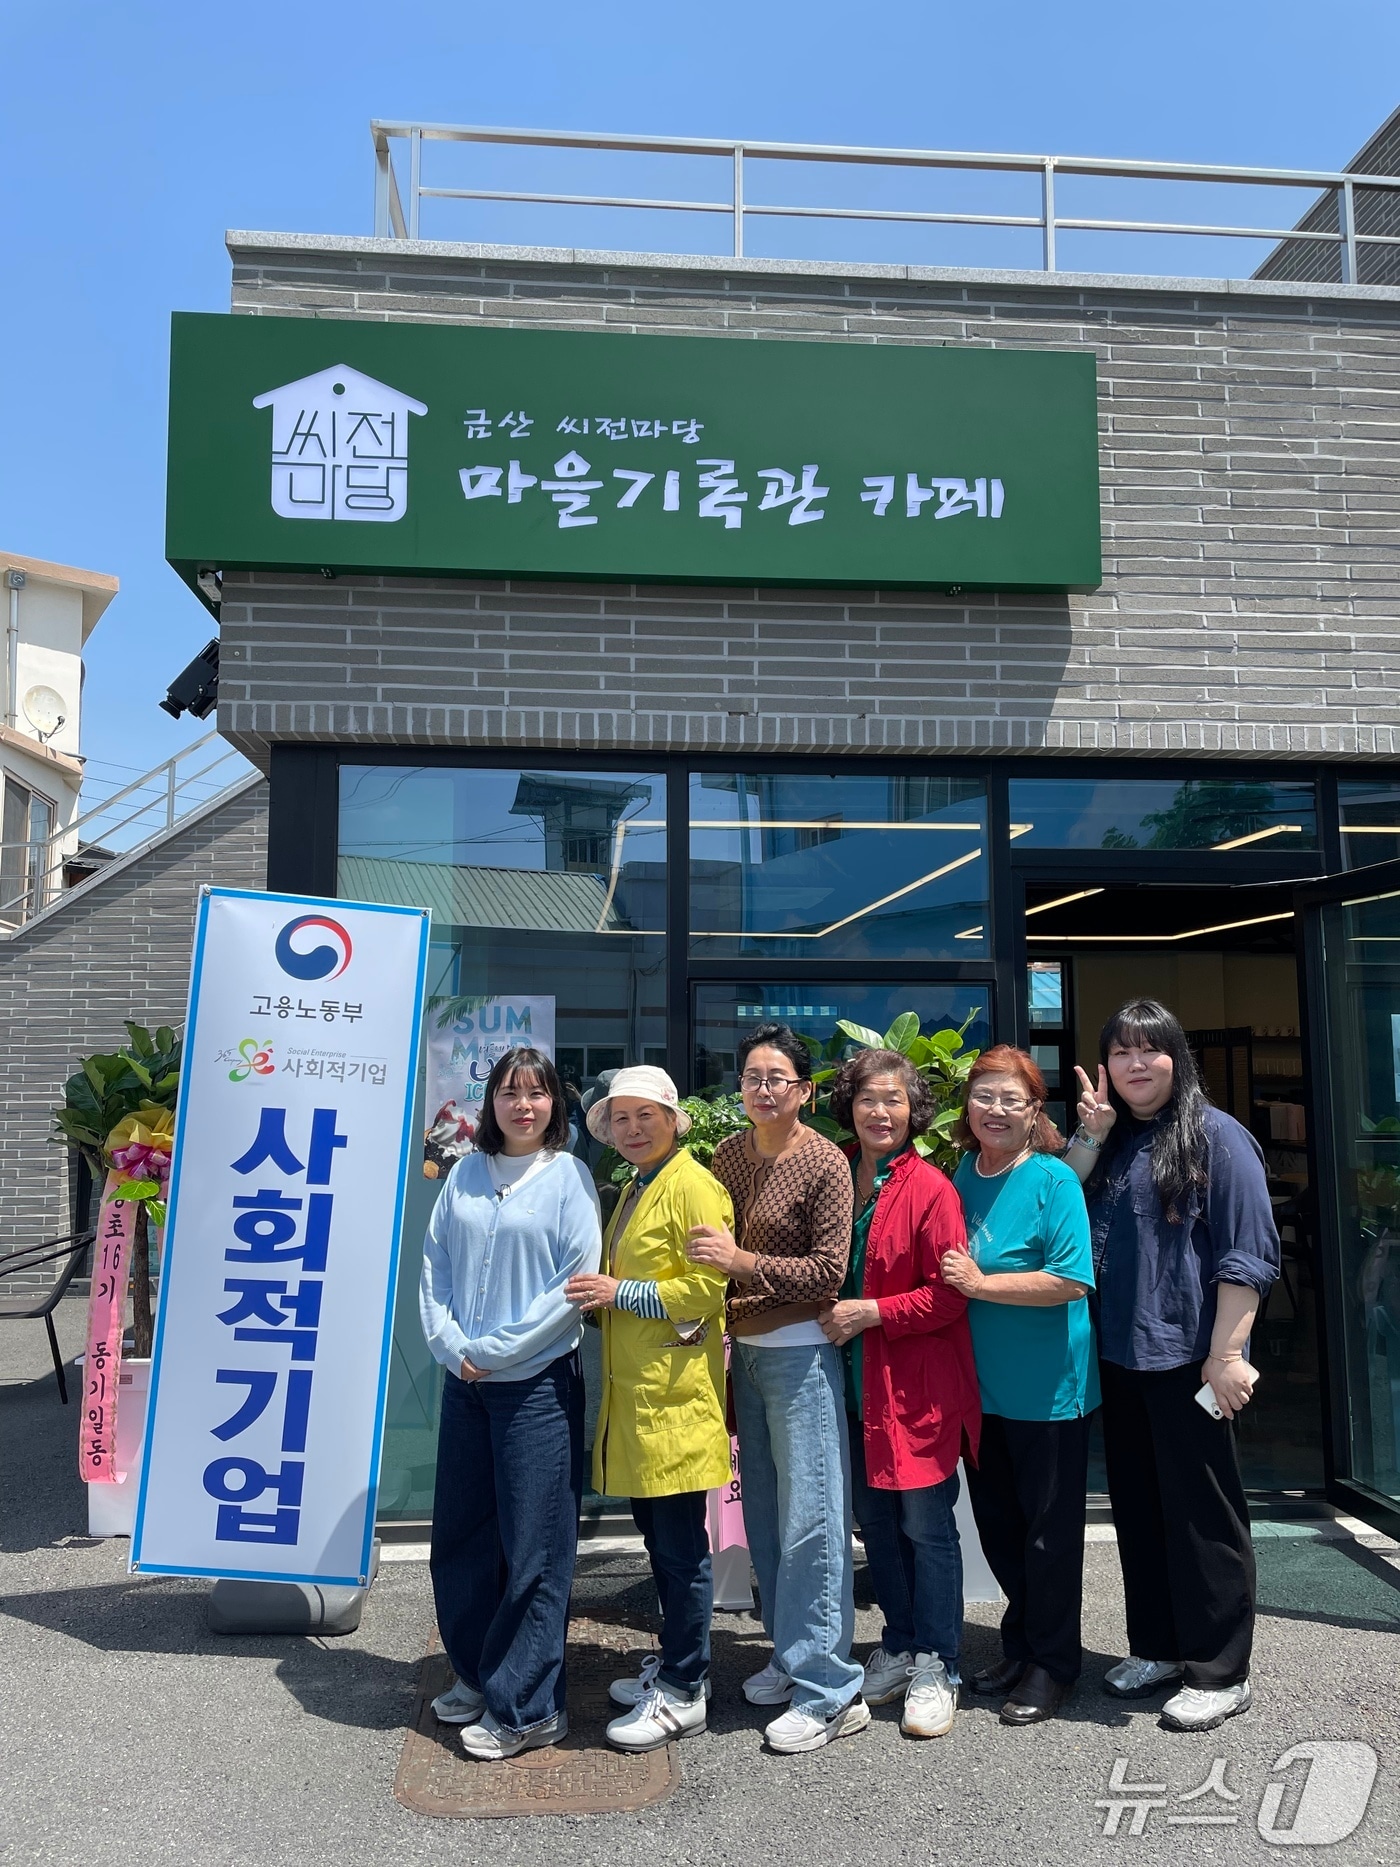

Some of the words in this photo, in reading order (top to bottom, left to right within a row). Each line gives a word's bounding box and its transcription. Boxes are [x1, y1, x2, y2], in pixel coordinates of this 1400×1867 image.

[463, 408, 535, 439] 금산
[556, 415, 705, 444] 씨전마당
[458, 450, 830, 528] 마을기록관
[860, 472, 1005, 520] 카페
[249, 995, 363, 1024] 고용노동부
[452, 1005, 533, 1035] SUM
[287, 1046, 310, 1056] Social
[311, 1049, 347, 1060] Enterprise
[281, 1057, 388, 1086] 사회적기업
[202, 1106, 349, 1547] 사회적기업
[86, 1341, 112, 1467] 동기일동
